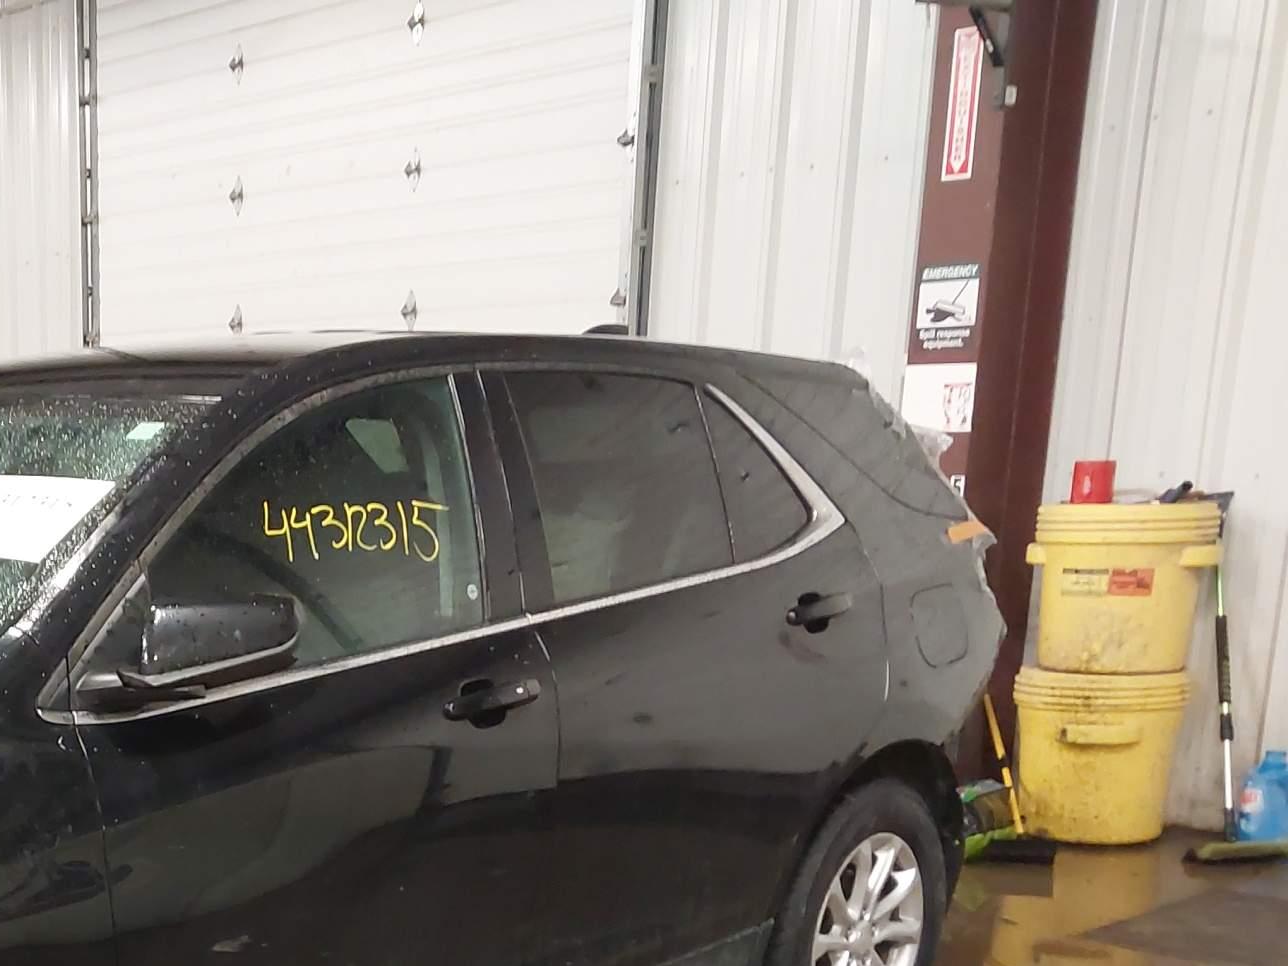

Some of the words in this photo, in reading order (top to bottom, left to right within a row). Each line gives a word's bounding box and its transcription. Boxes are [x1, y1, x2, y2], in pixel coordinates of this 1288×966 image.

[922, 263, 978, 281] EMERGENCY
[919, 327, 936, 340] Spill
[936, 326, 970, 340] response
[263, 499, 450, 563] 44312315
